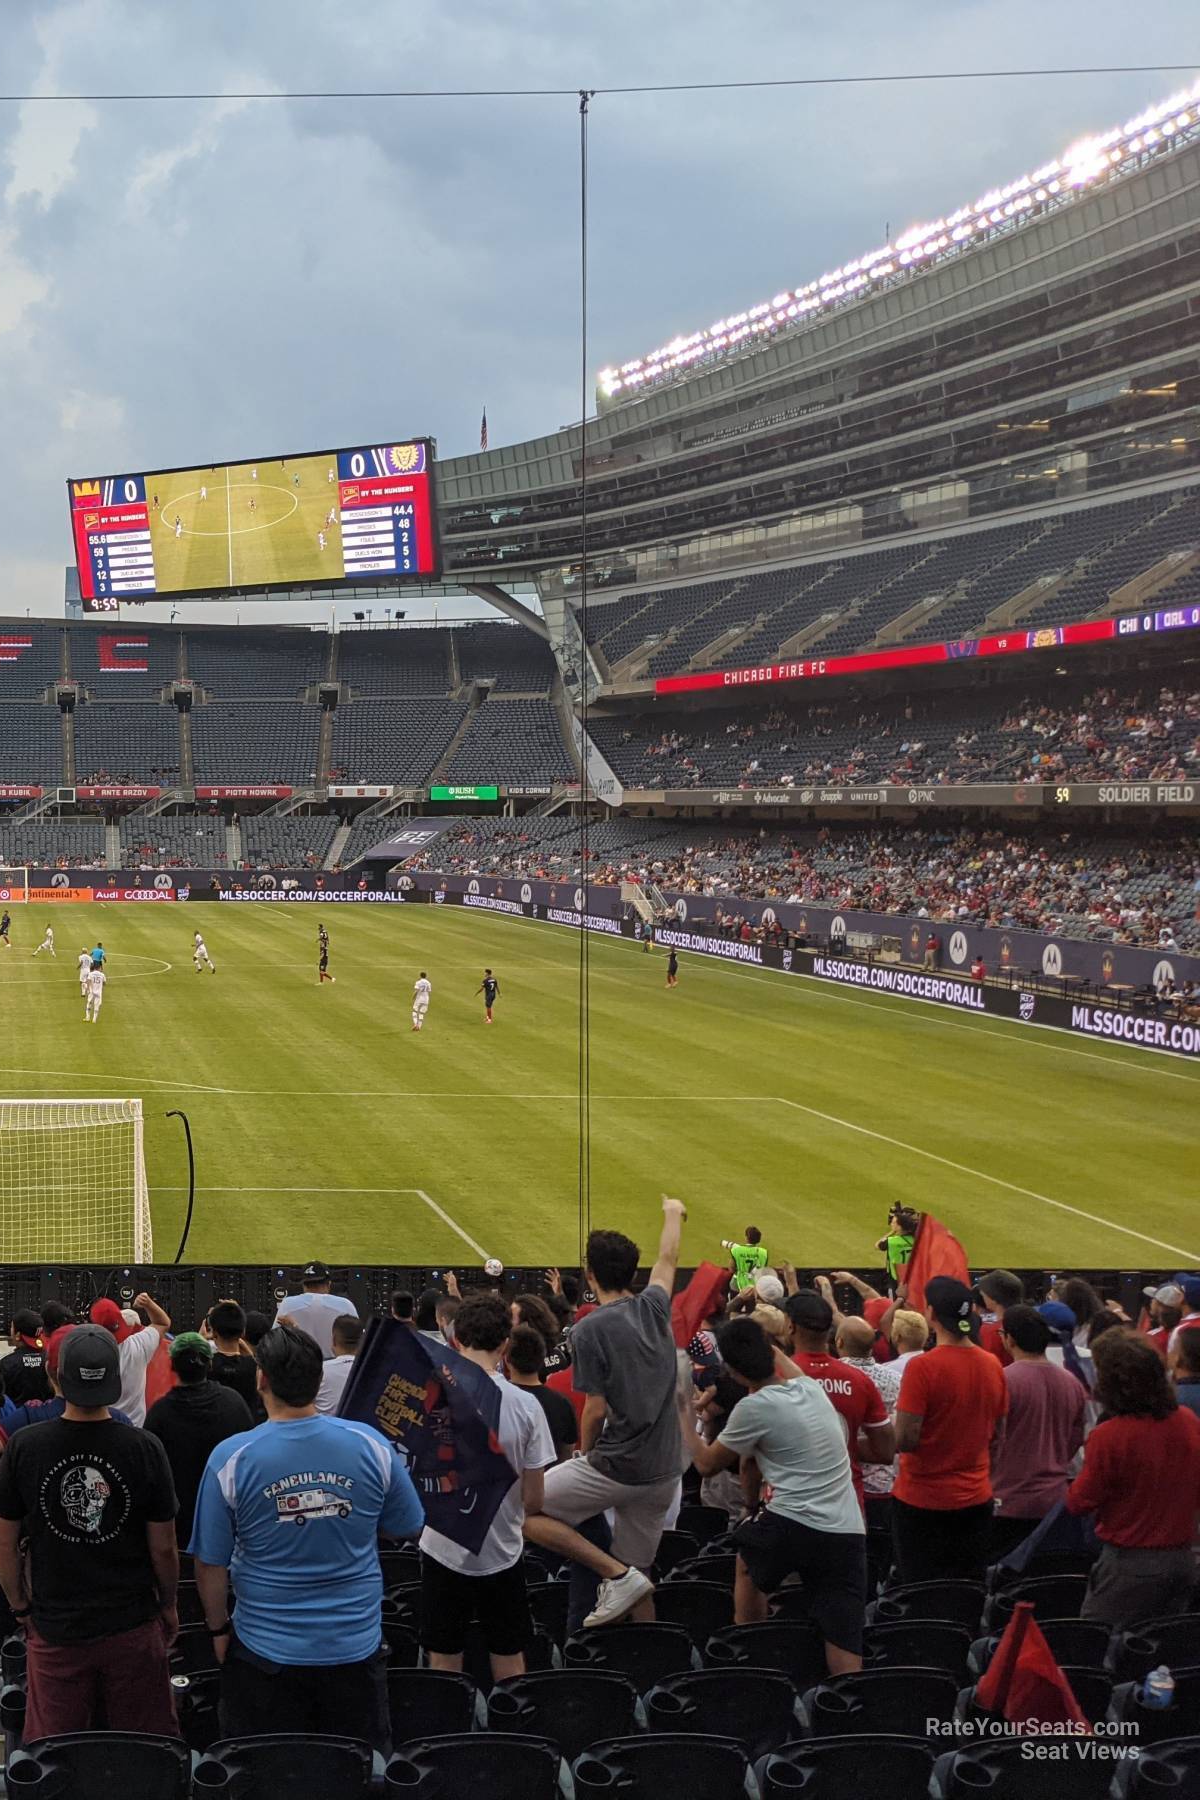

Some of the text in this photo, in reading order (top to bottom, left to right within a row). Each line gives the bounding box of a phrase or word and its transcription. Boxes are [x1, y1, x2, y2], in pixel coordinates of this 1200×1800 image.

[350, 453, 365, 477] 0
[124, 480, 138, 502] 0
[384, 486, 414, 494] NUMBERS
[394, 504, 413, 515] 44.4
[120, 513, 146, 521] NUMBERS
[398, 519, 410, 528] 48
[402, 532, 408, 542] 2
[94, 548, 104, 557] 59
[403, 546, 409, 556] 5
[97, 559, 103, 568] 3
[403, 559, 410, 569] 3
[96, 571, 107, 580] 12
[100, 583, 106, 592] 3
[91, 598, 118, 610] 9:59
[1164, 608, 1199, 627] ORL 0
[1119, 616, 1151, 633] CHI 0
[998, 640, 1007, 648] VS
[724, 661, 826, 685] CHICAGO FIRE FC
[8, 789, 31, 797] KUBIK
[455, 787, 475, 795] RUSH
[1098, 786, 1194, 802] SOLDIER FIELD
[762, 793, 790, 803] Advocate
[850, 793, 879, 801] UNITED
[917, 791, 936, 802] PNC
[95, 891, 118, 899] Audi
[219, 890, 405, 901] MLSSOCCER.COM/SOCCERFORALL
[463, 894, 524, 915] MLSSOCCER.COM/SOCCERFORALL
[654, 928, 763, 963] MLSSOCCER.COM/SOCCERFORALL
[813, 959, 985, 1008] MLSSOCCER.COM/SOCCERFORALL
[388, 1373, 428, 1400] CHICAGO
[384, 1386, 408, 1404] FIRE
[375, 1406, 400, 1425] CLUB
[378, 1395, 423, 1426] FOOTBALL
[70, 1454, 84, 1462] OFF
[89, 1454, 103, 1463] THE
[262, 1471, 355, 1499] FANBULANCE
